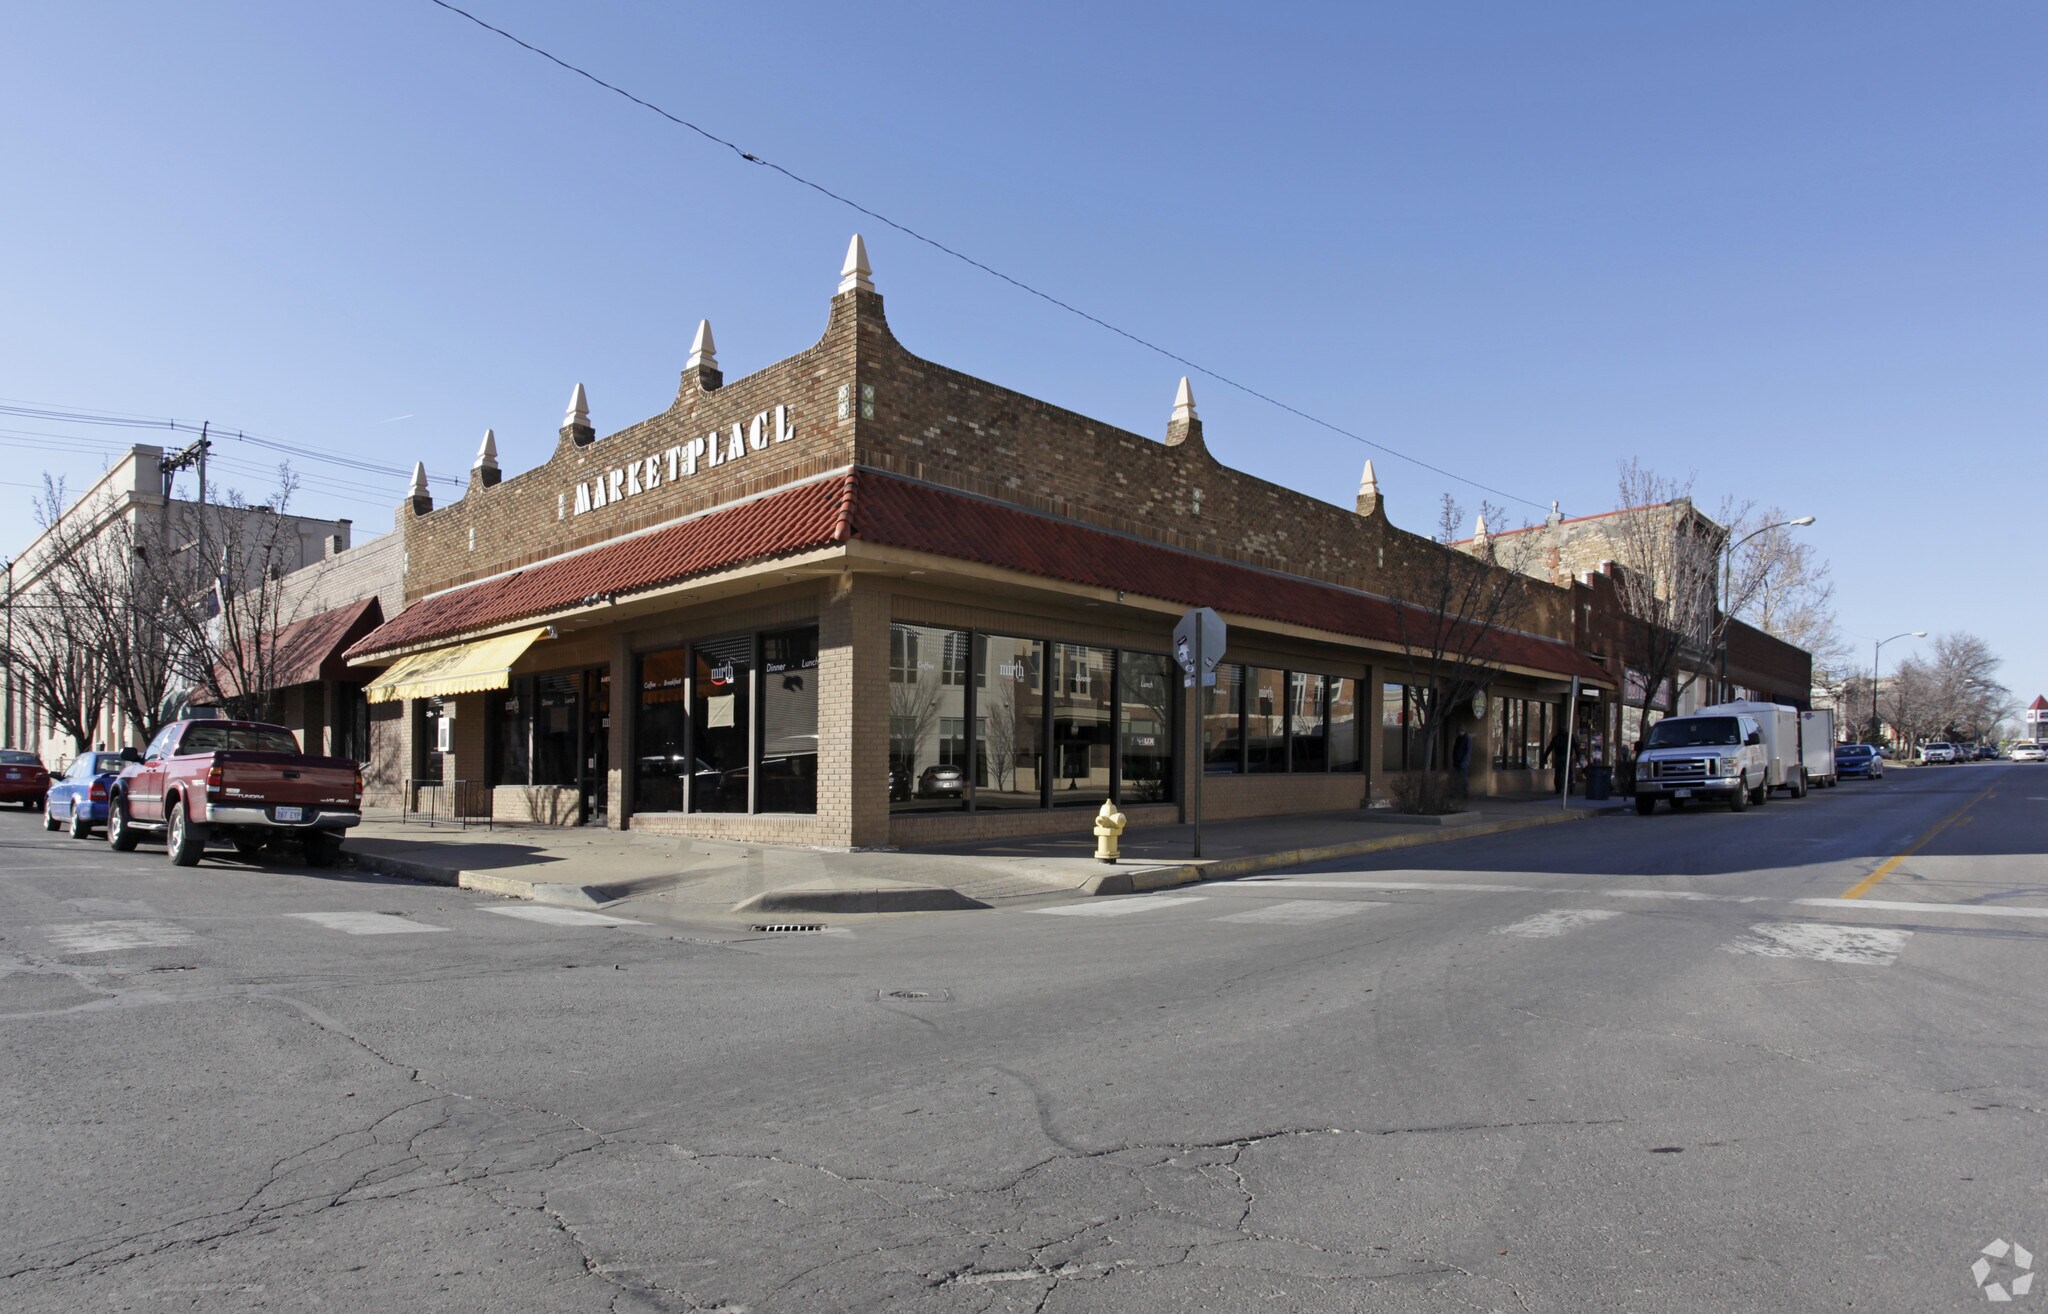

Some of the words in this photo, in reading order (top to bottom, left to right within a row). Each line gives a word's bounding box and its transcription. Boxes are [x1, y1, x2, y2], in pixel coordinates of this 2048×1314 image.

[711, 661, 734, 680] mirth
[766, 663, 786, 672] Dinner
[917, 661, 934, 671] Coffee
[1000, 660, 1024, 679] mirth
[1141, 680, 1153, 688] Lunch
